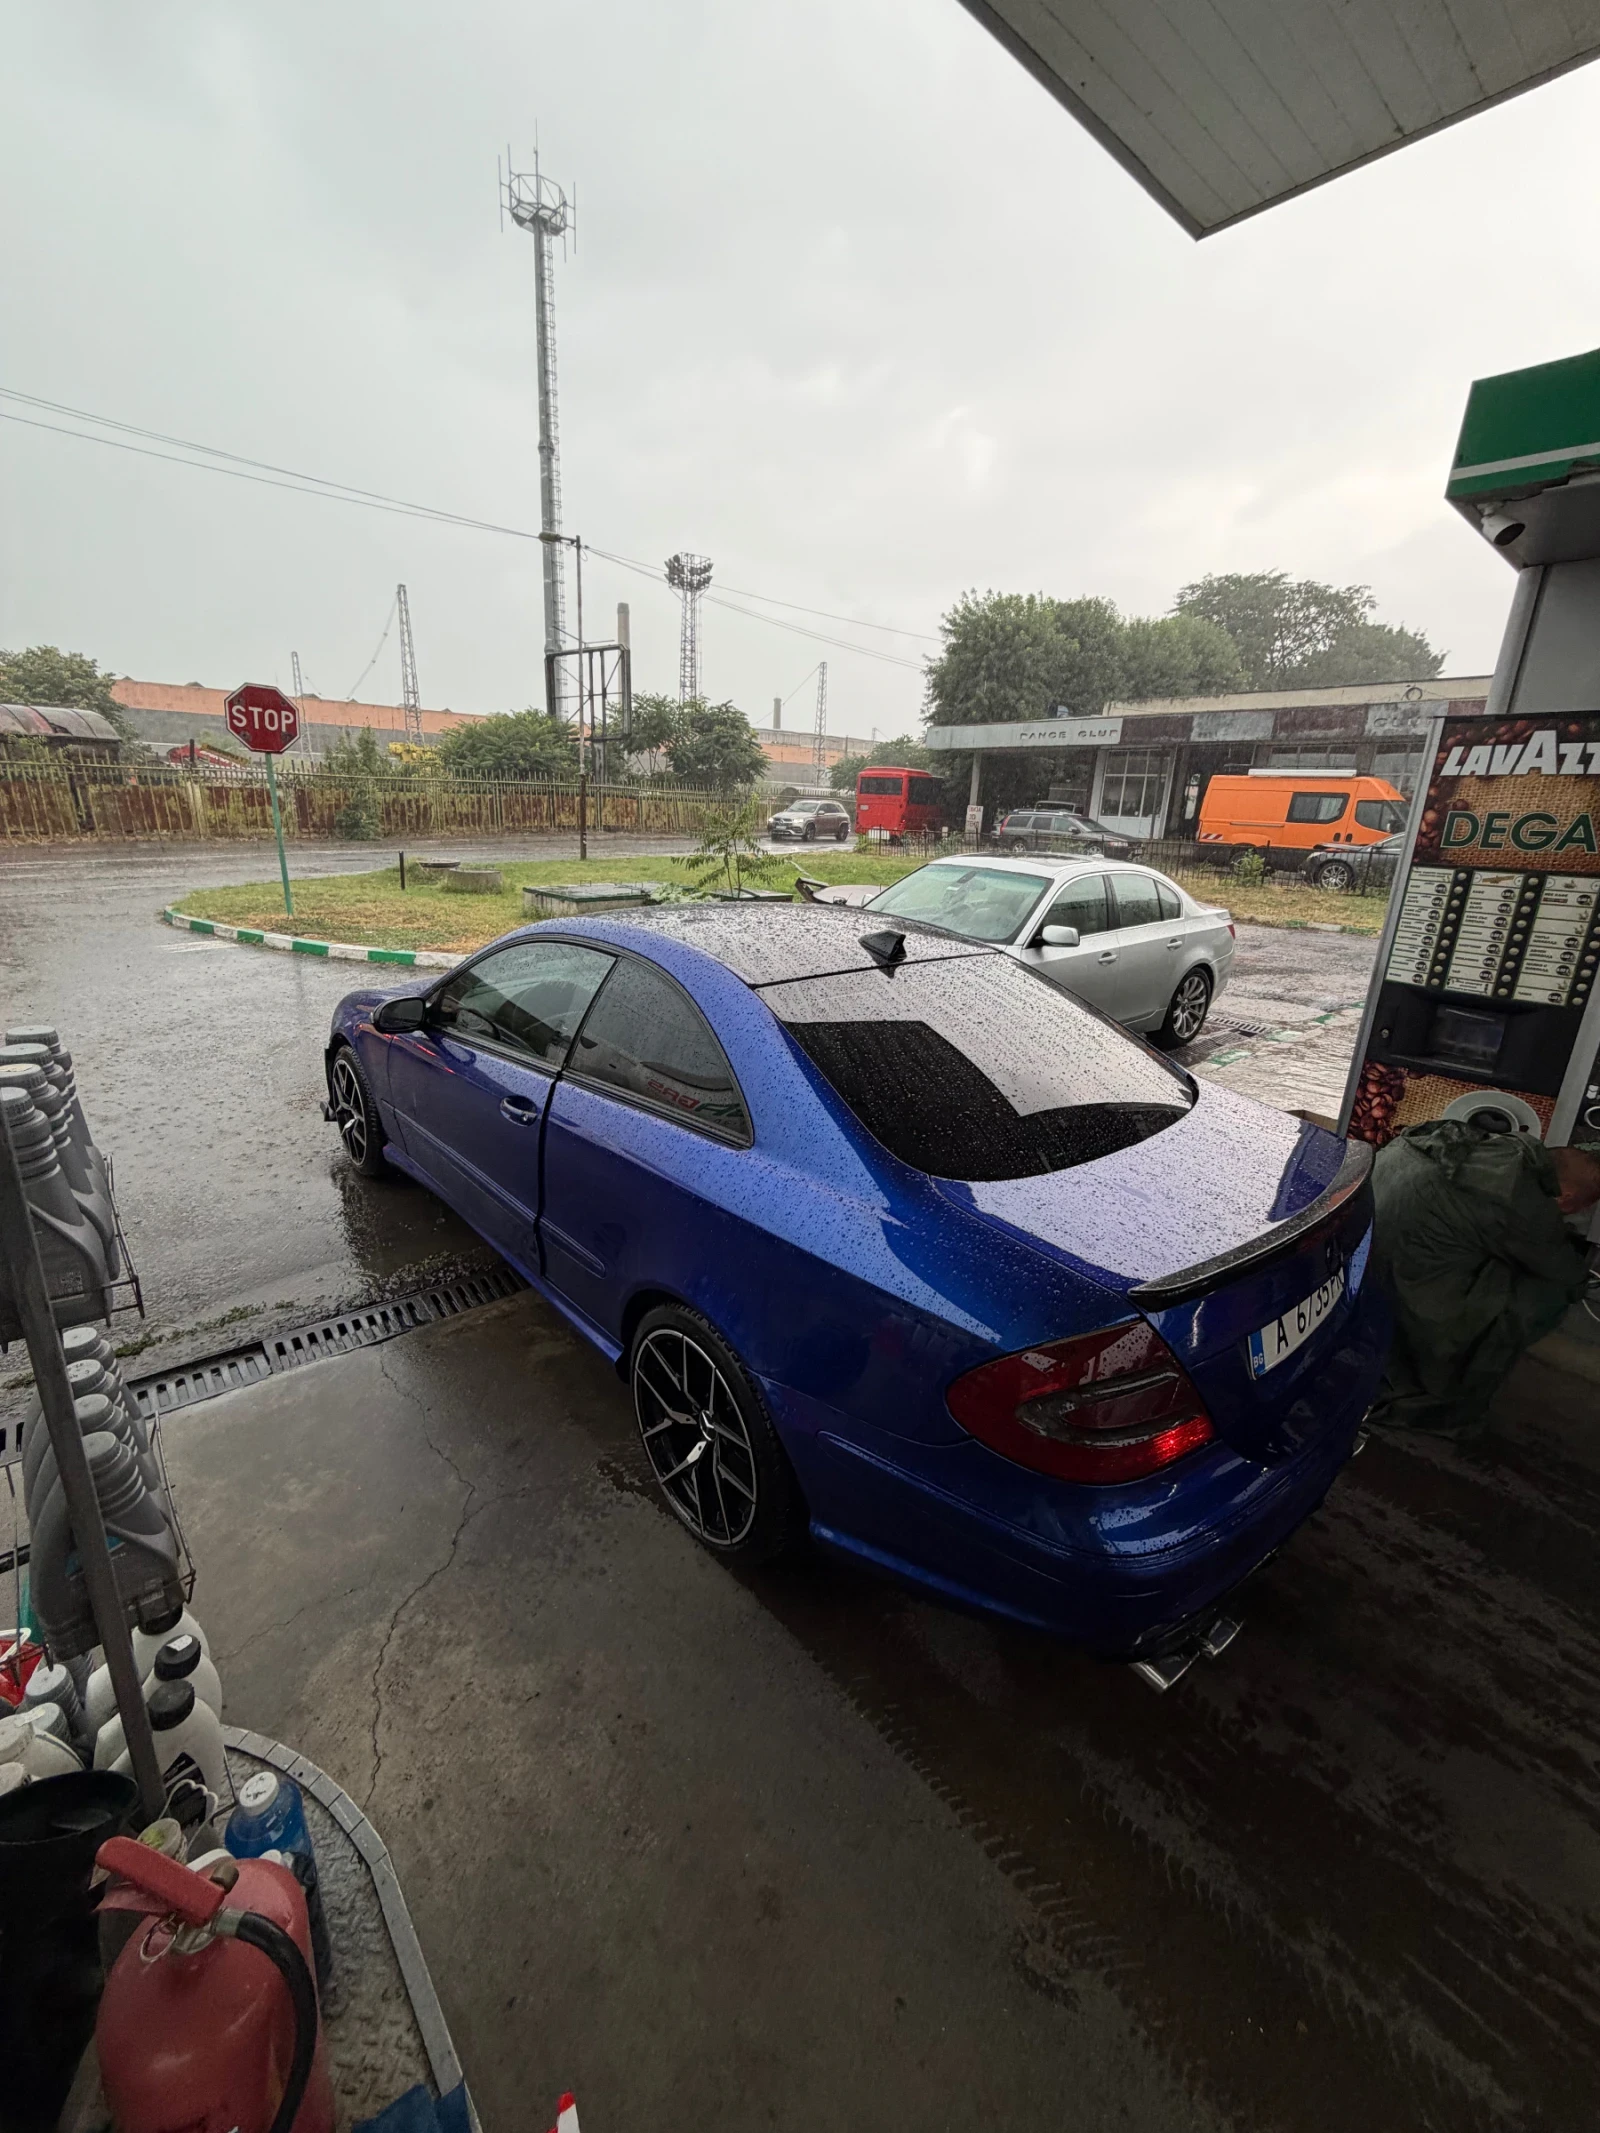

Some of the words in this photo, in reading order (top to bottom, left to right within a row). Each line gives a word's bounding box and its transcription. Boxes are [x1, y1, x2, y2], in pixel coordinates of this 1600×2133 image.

[231, 705, 294, 732] STOP
[1440, 811, 1598, 853] DEGA
[1276, 1317, 1289, 1354] A
[1253, 1352, 1264, 1368] BG
